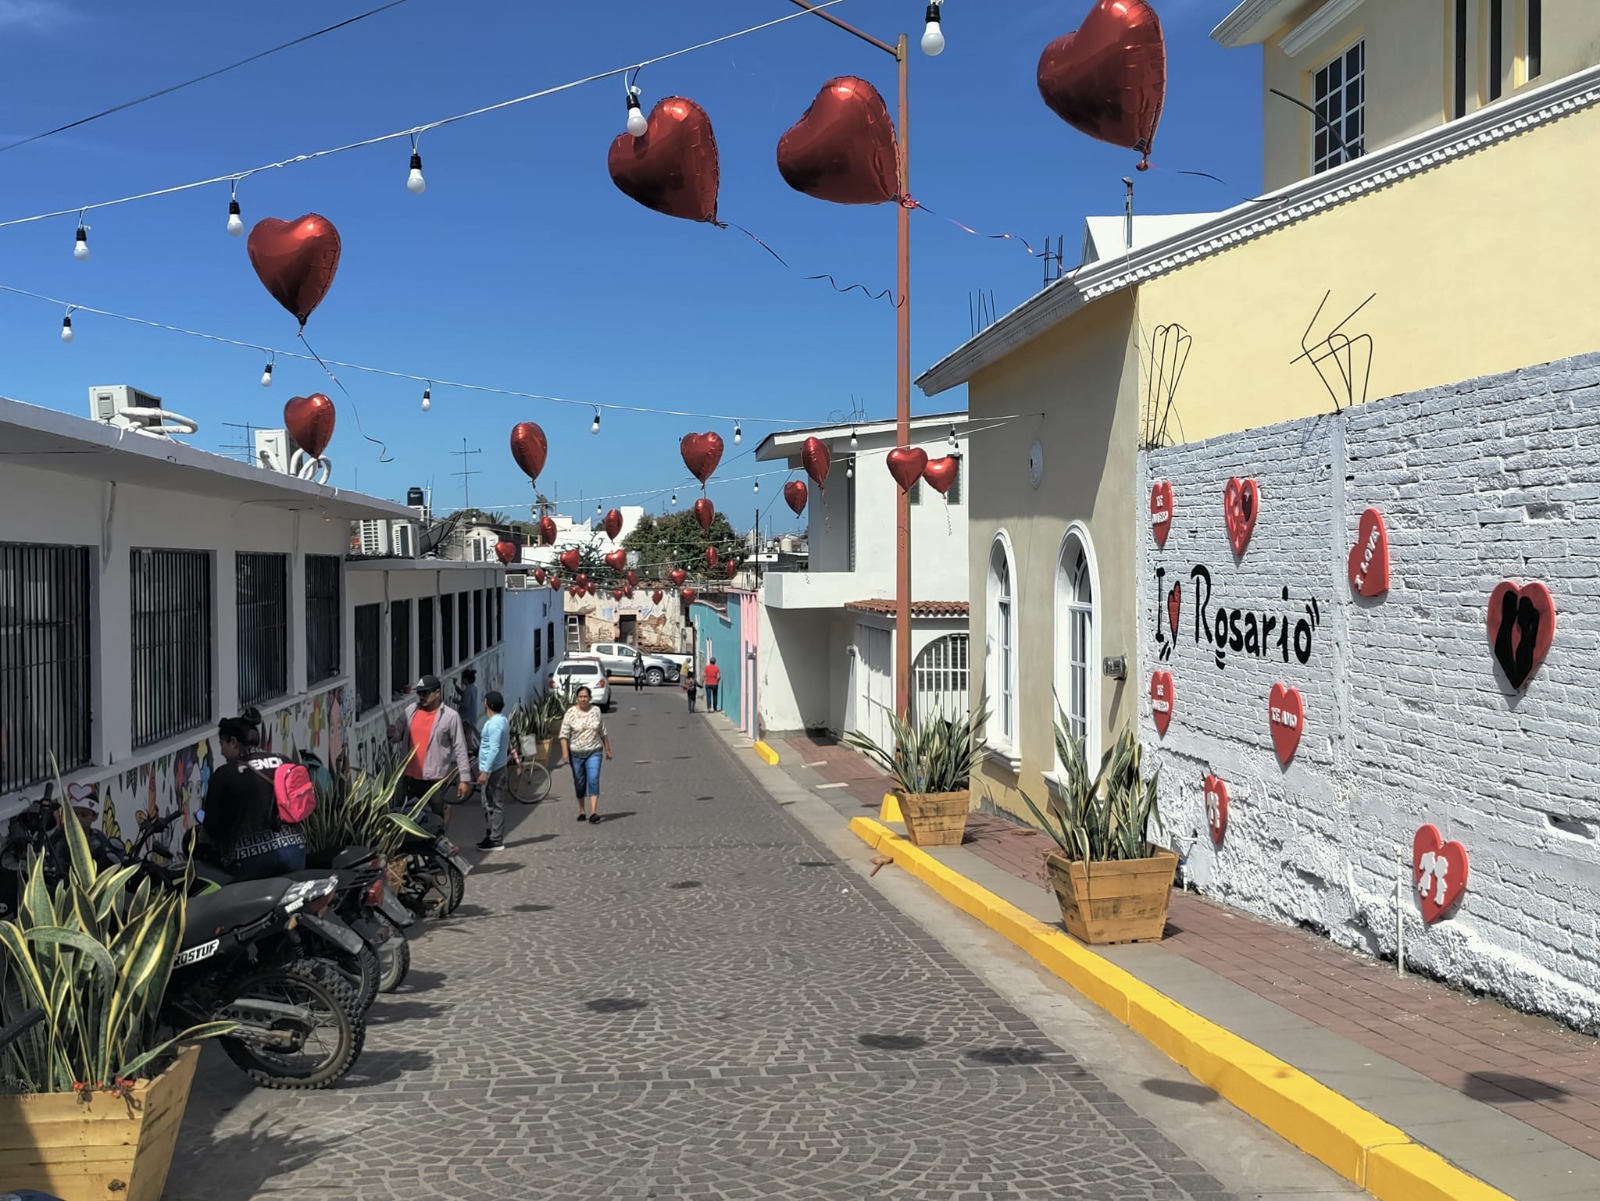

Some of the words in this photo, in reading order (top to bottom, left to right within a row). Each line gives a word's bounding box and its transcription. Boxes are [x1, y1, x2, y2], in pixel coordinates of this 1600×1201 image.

[1190, 564, 1312, 665] Rosario
[1271, 706, 1281, 722] TE
[1281, 710, 1298, 728] AMO
